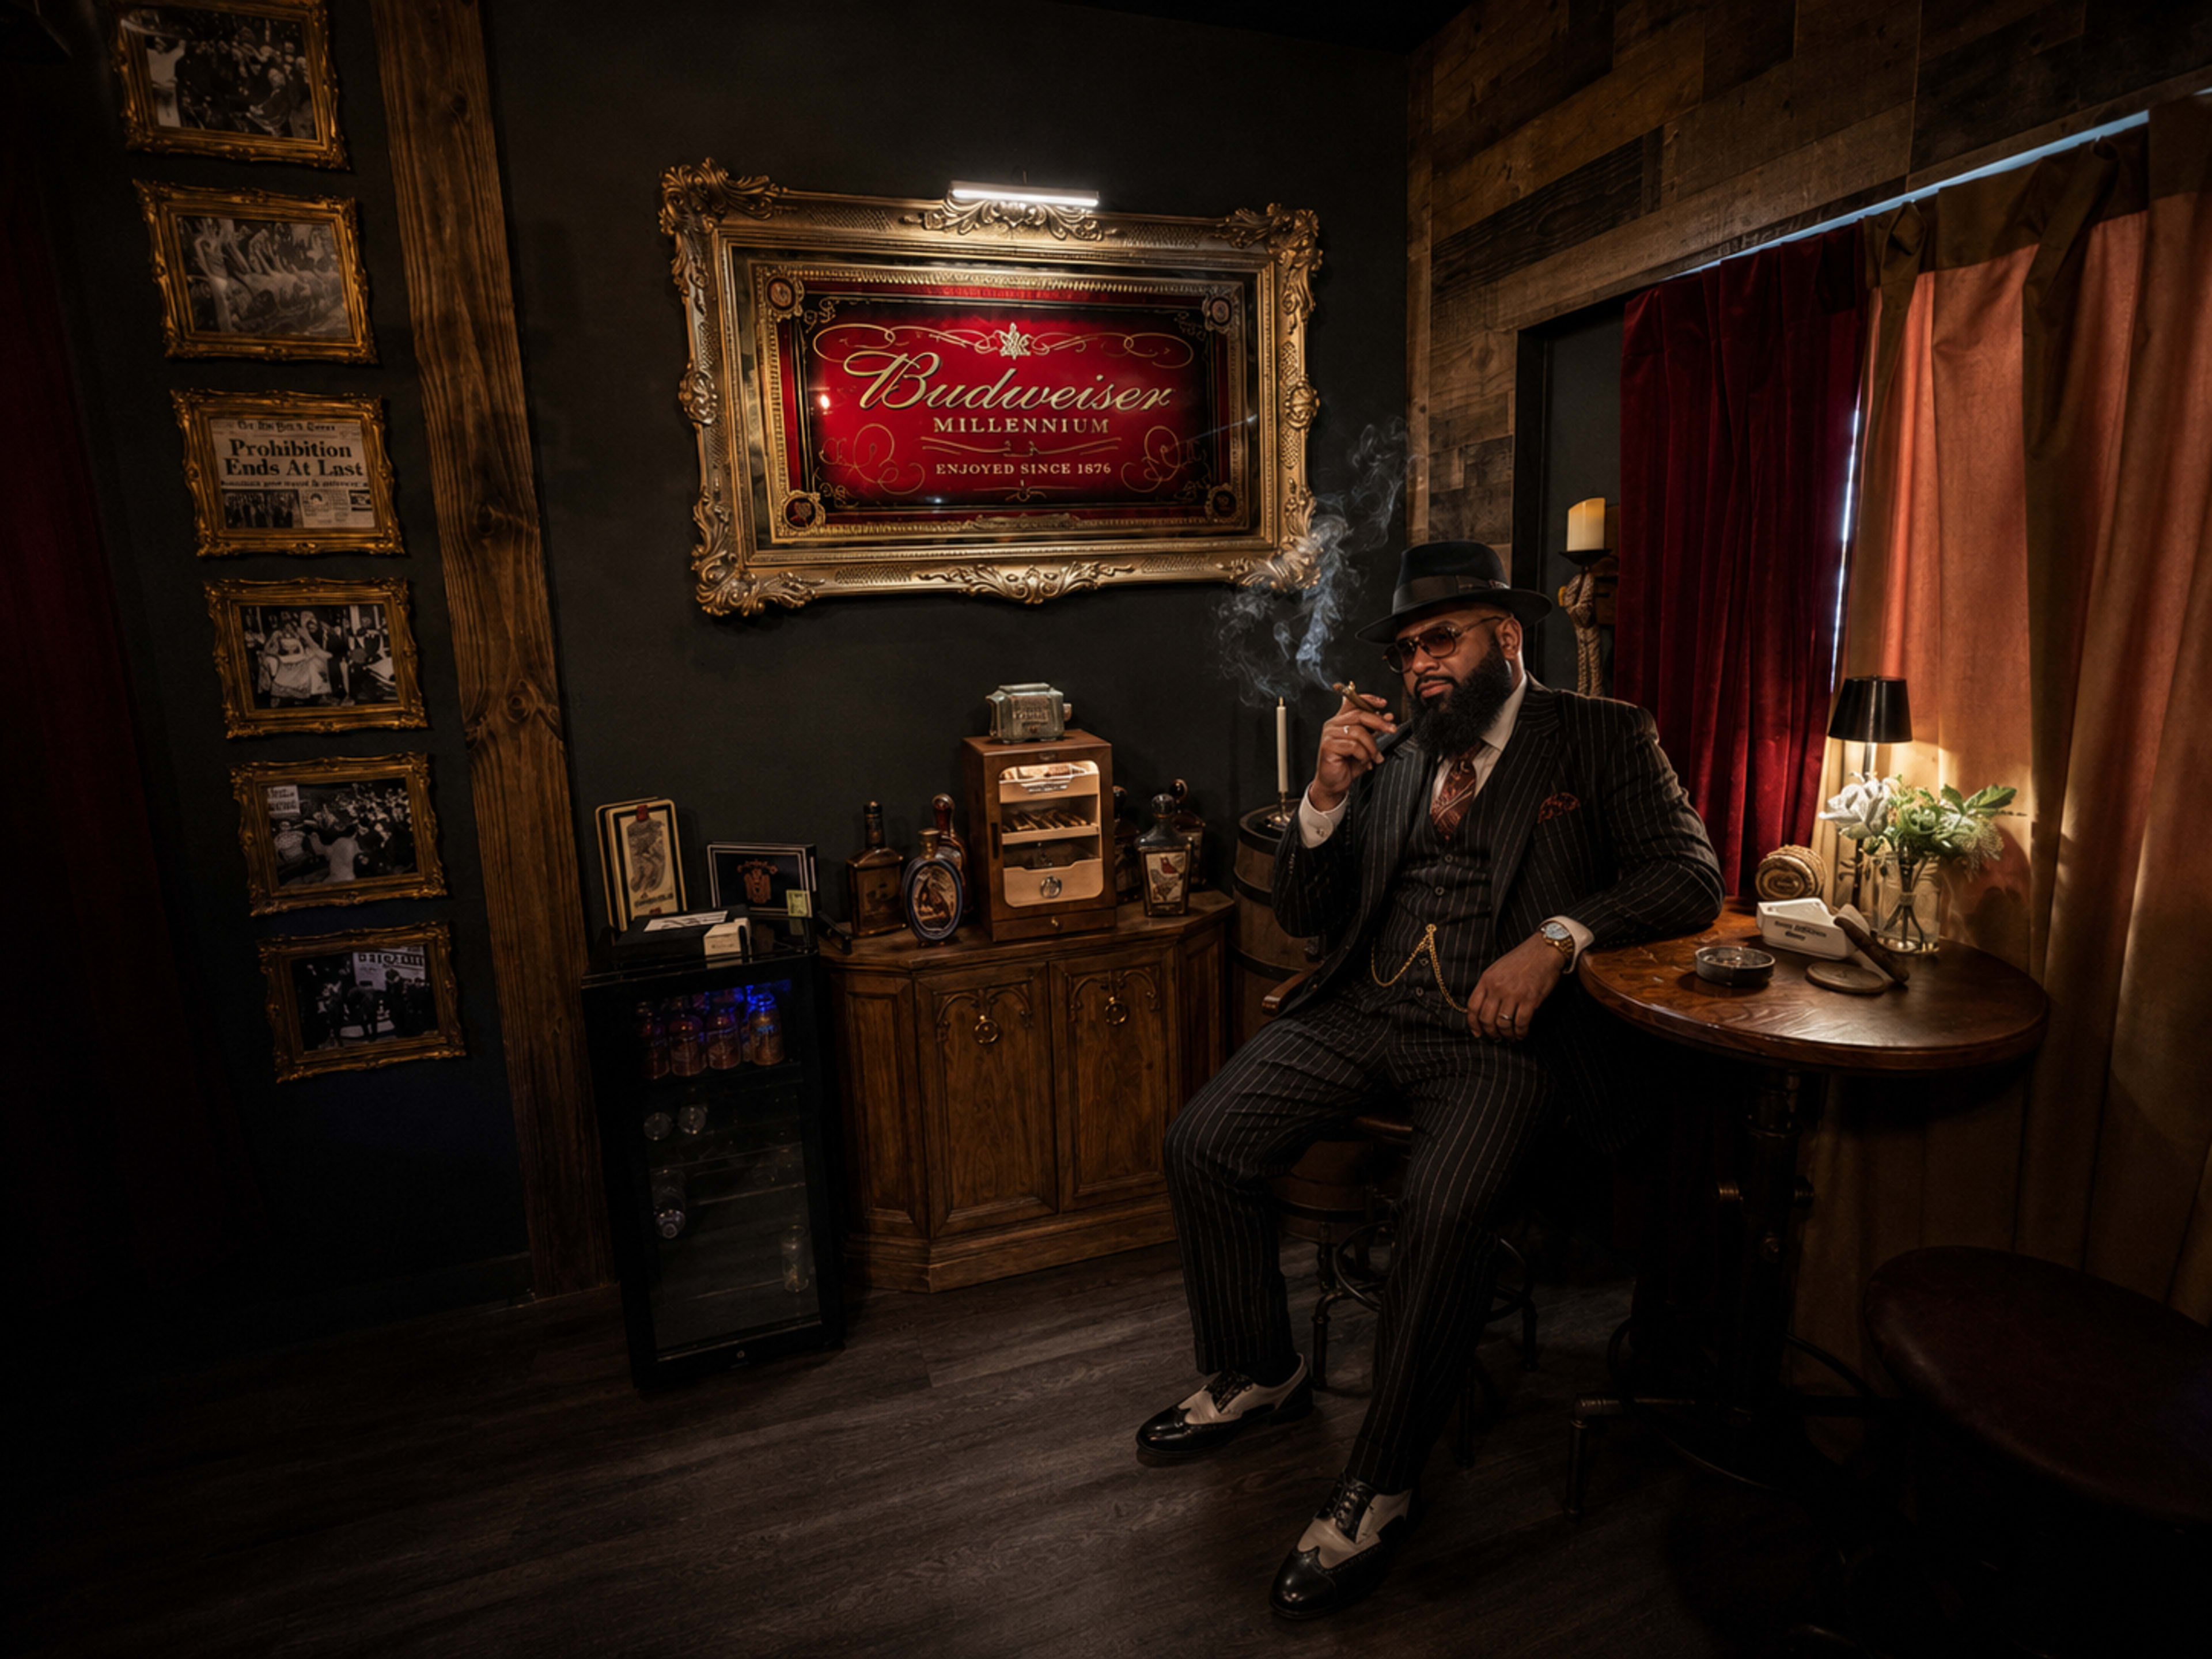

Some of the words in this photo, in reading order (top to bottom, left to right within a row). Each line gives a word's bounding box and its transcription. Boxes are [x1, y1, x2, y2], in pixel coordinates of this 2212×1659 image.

[843, 351, 1173, 411] Budweiser
[933, 417, 1109, 434] MILLENNIUM
[229, 438, 352, 458] Prohibition
[224, 457, 279, 475] Ends
[286, 459, 310, 476] At
[317, 460, 363, 476] Last
[935, 463, 1015, 475] ENJOYED
[1020, 463, 1071, 475] SINCE
[1077, 463, 1112, 475] 1876
